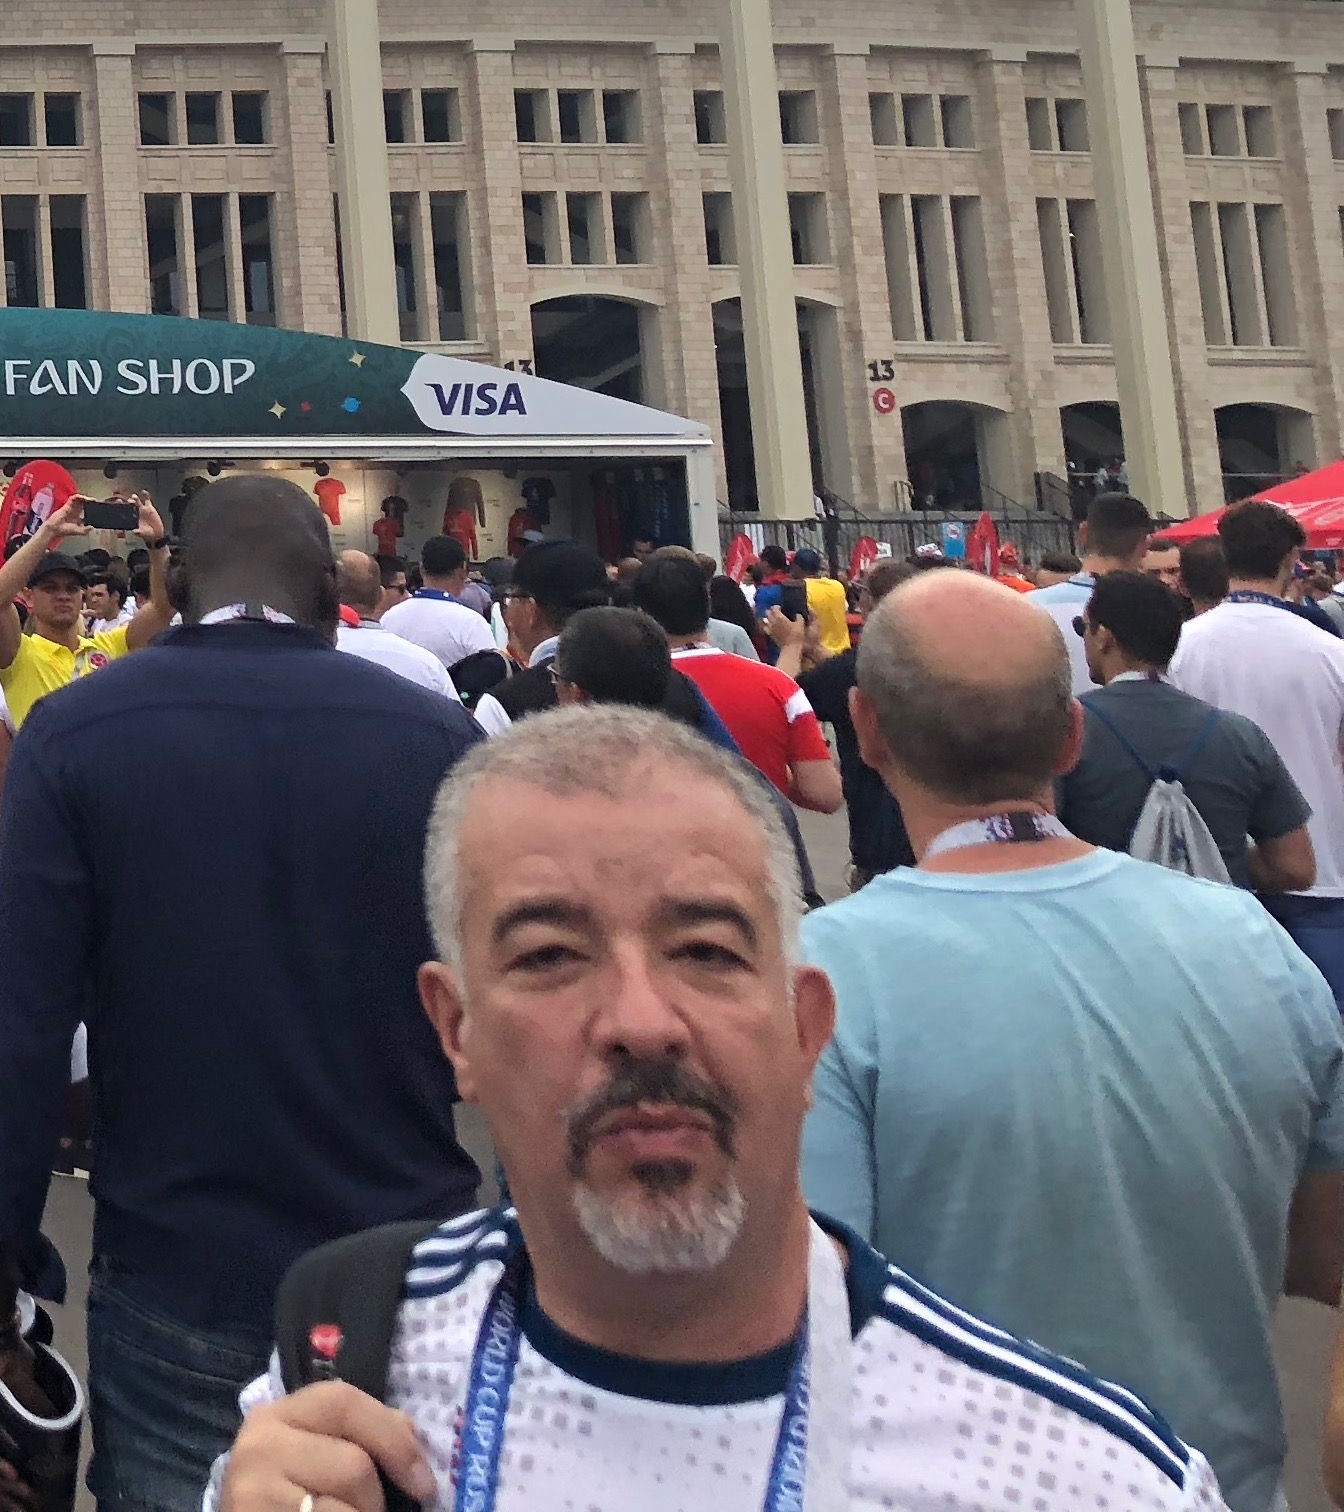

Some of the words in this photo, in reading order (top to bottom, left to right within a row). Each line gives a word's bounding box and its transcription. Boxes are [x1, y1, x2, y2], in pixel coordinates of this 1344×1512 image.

[5, 359, 102, 395] FAN
[117, 358, 256, 395] SHOP
[868, 360, 894, 381] 13
[424, 382, 527, 416] VISA
[472, 1386, 501, 1447] CUP
